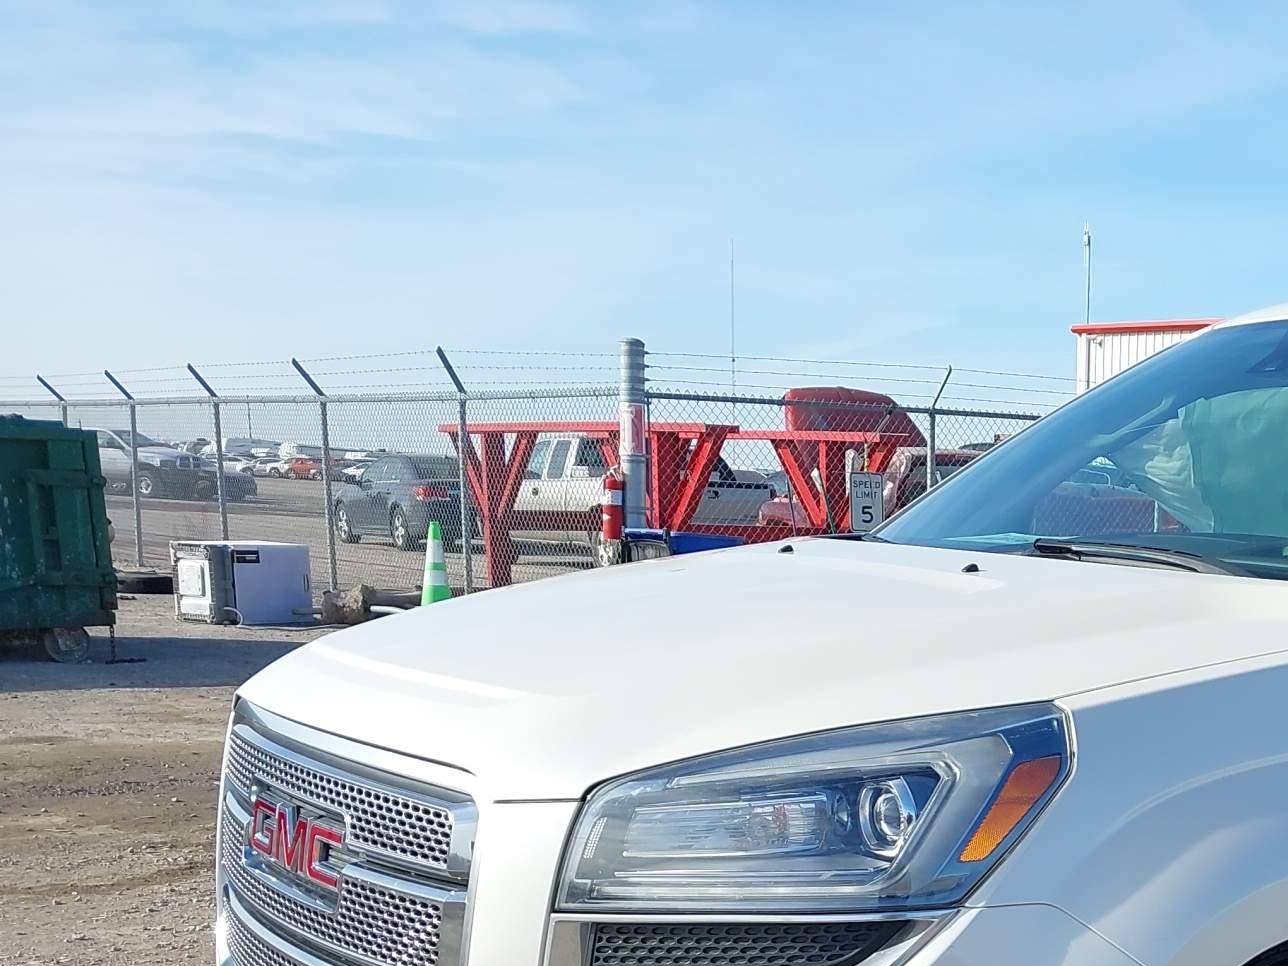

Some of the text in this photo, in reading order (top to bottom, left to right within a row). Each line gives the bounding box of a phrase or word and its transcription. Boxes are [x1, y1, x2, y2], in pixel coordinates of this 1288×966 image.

[852, 480, 881, 489] SPEED
[855, 490, 878, 499] LIMIT
[861, 505, 874, 524] 5
[249, 799, 345, 891] GMC
